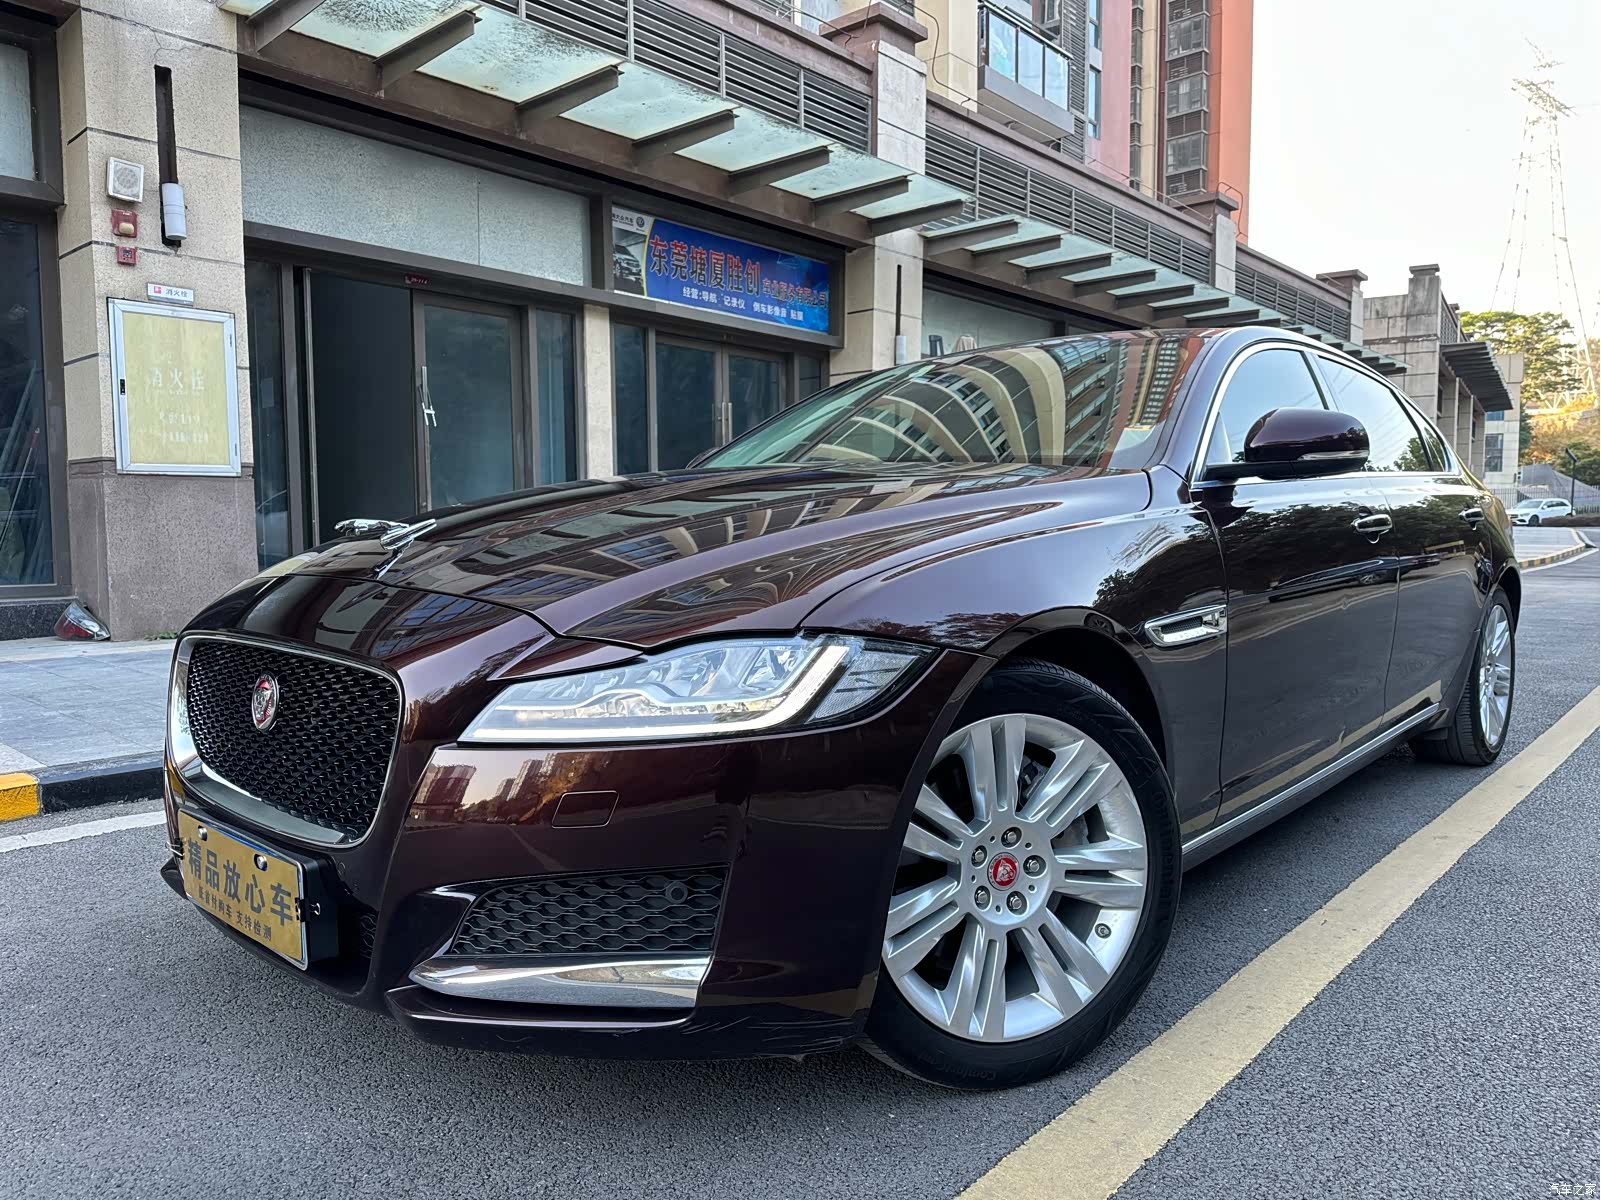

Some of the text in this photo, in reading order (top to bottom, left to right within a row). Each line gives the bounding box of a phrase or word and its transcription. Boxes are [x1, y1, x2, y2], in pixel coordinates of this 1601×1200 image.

[649, 235, 761, 296] 东莞塘厦胜创
[165, 287, 188, 297] 消火栓
[188, 839, 293, 926] 精品放心车
[236, 909, 272, 942] 支持检测
